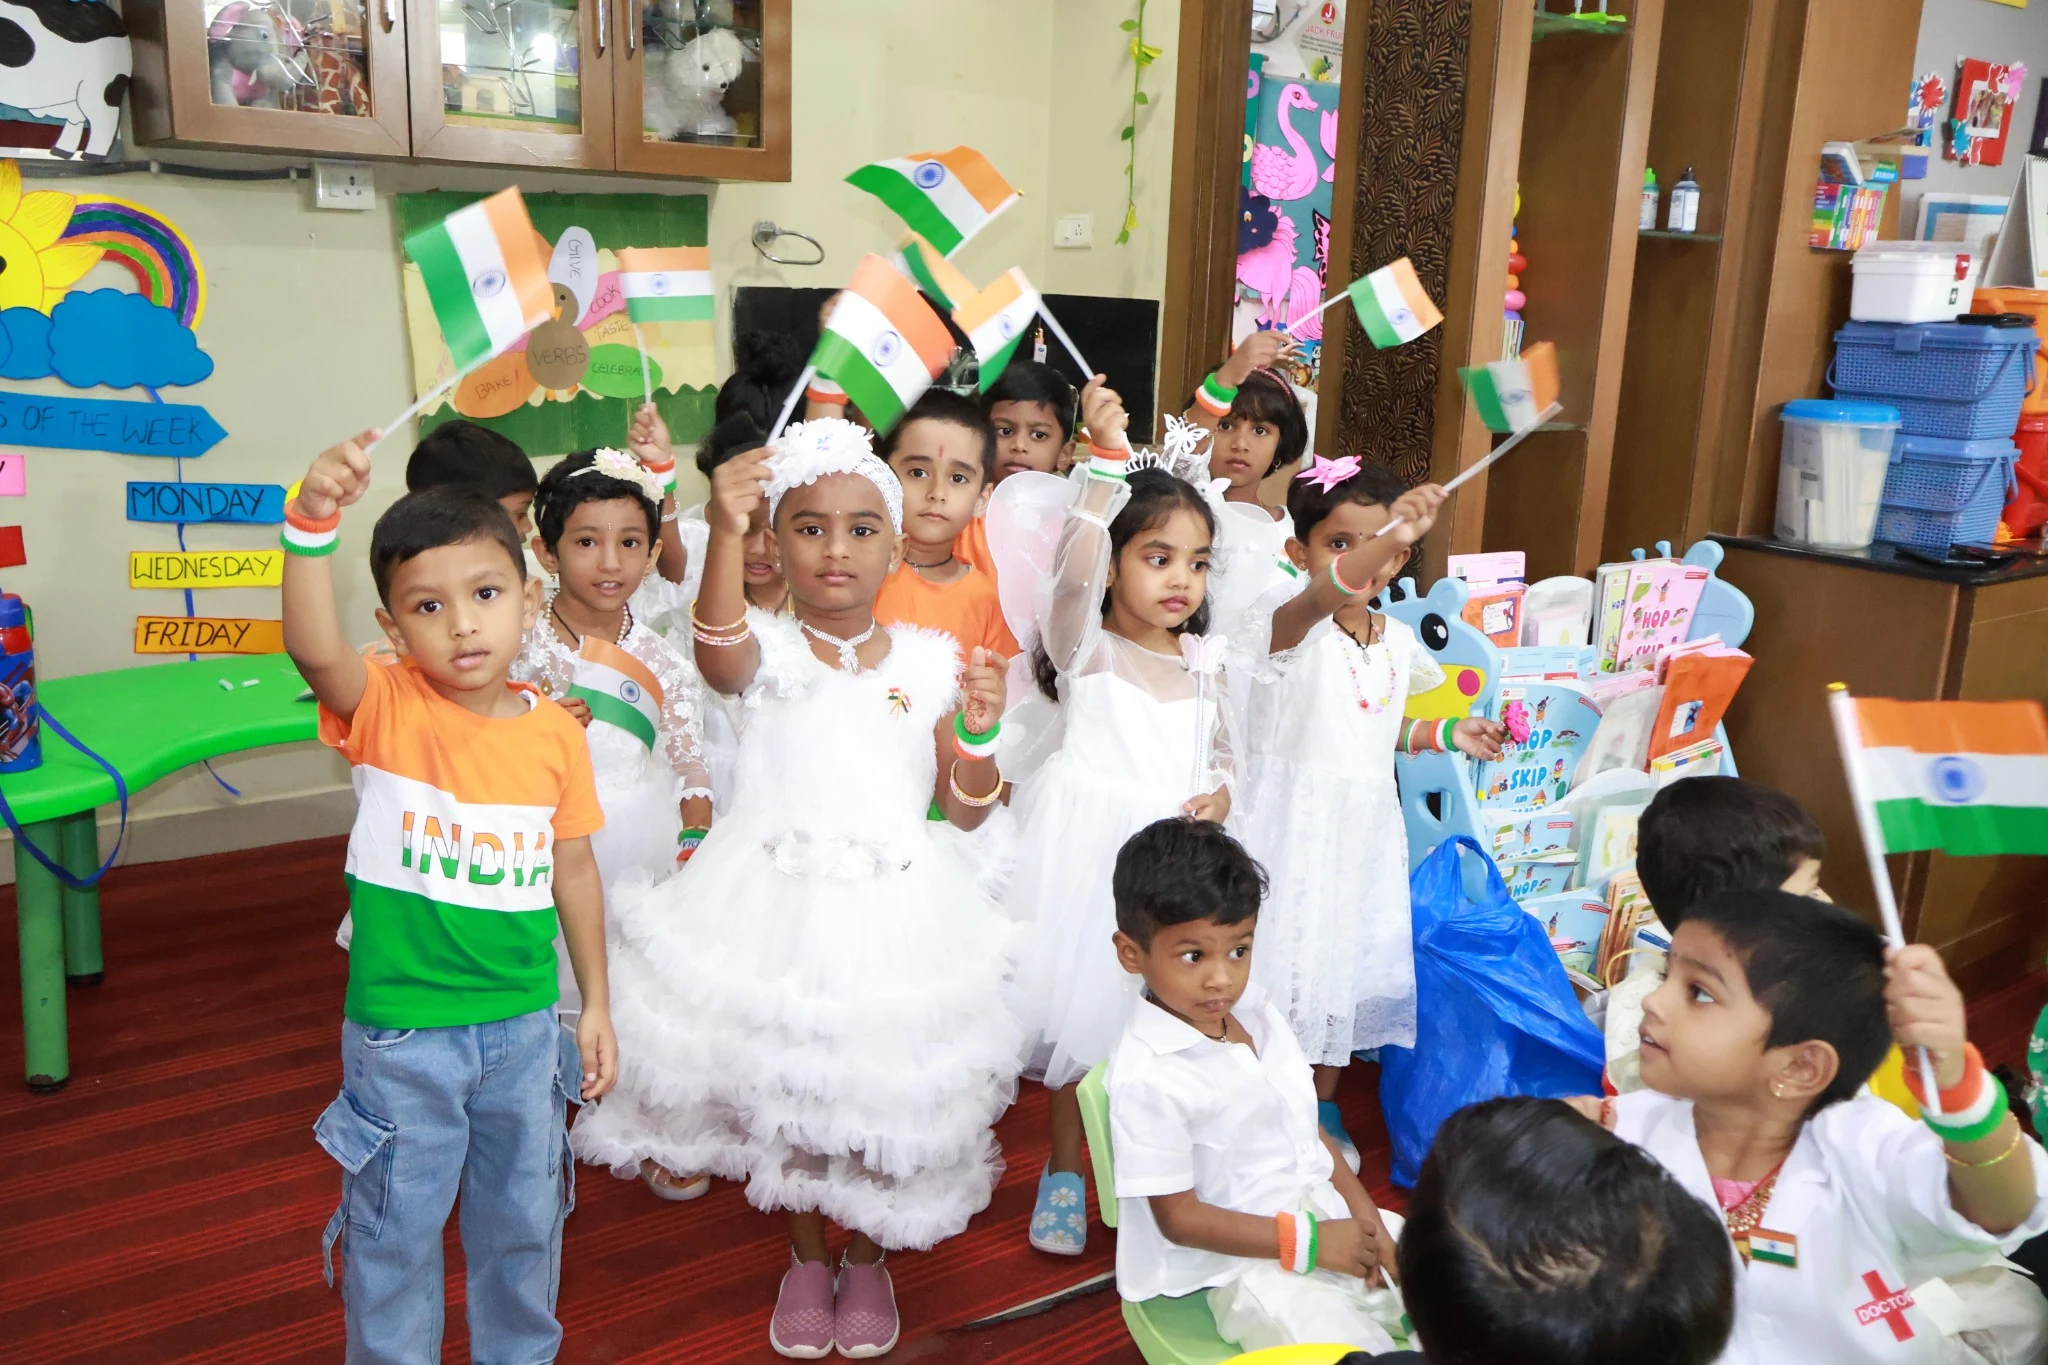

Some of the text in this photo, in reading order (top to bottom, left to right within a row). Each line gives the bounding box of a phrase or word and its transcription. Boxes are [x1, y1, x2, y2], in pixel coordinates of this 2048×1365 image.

[1305, 24, 1325, 36] JACK
[567, 238, 584, 279] GIVE
[590, 284, 622, 314] COOK
[594, 320, 629, 341] TASTE
[533, 345, 587, 367] VERBS
[23, 405, 56, 432] OF
[68, 410, 110, 437] THE
[121, 415, 206, 446] WEEK
[130, 484, 265, 517] MONDAY
[133, 555, 273, 581] WEDNESDAY
[1611, 599, 1626, 611] HOP
[1641, 609, 1671, 630] HOP
[143, 621, 251, 649] FRIDAY
[1509, 766, 1548, 791] SKIP
[401, 810, 551, 887] INDIA
[1512, 879, 1539, 898] HOP
